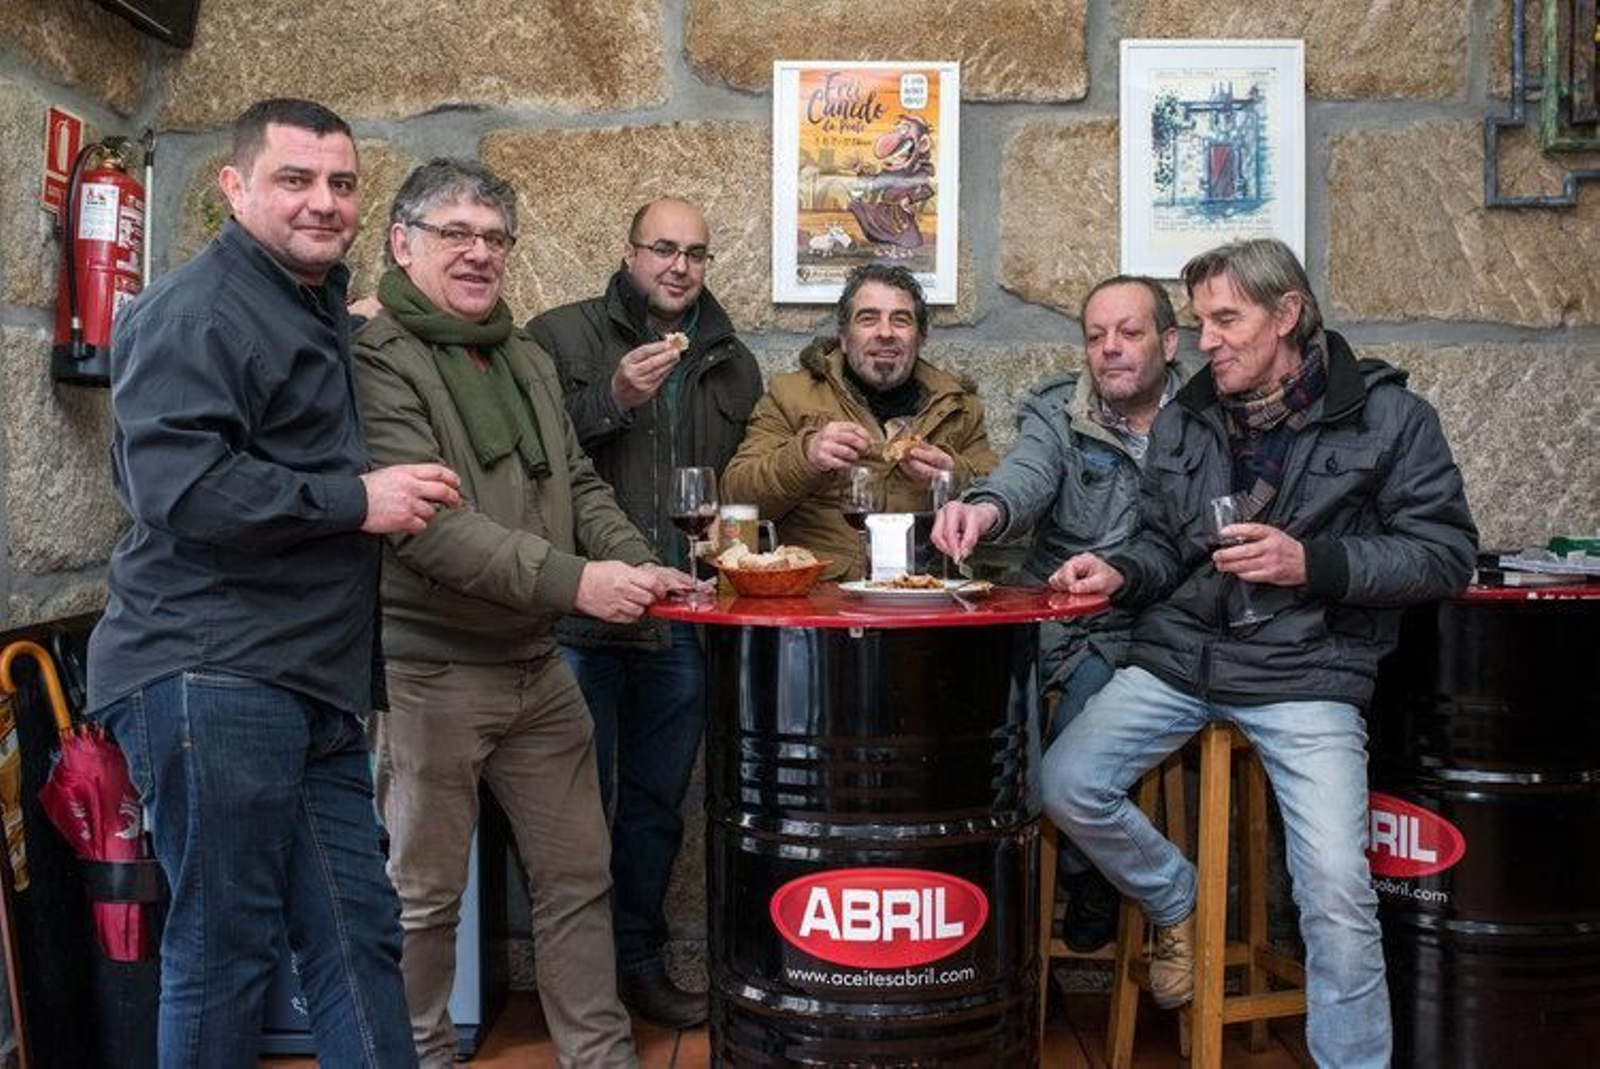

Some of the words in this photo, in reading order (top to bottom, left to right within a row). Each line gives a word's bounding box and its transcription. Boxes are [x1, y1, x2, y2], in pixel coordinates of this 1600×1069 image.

[1371, 809, 1437, 863] RIL
[799, 886, 965, 941] ABRIL
[786, 967, 975, 987] www.aceitesabril.com
